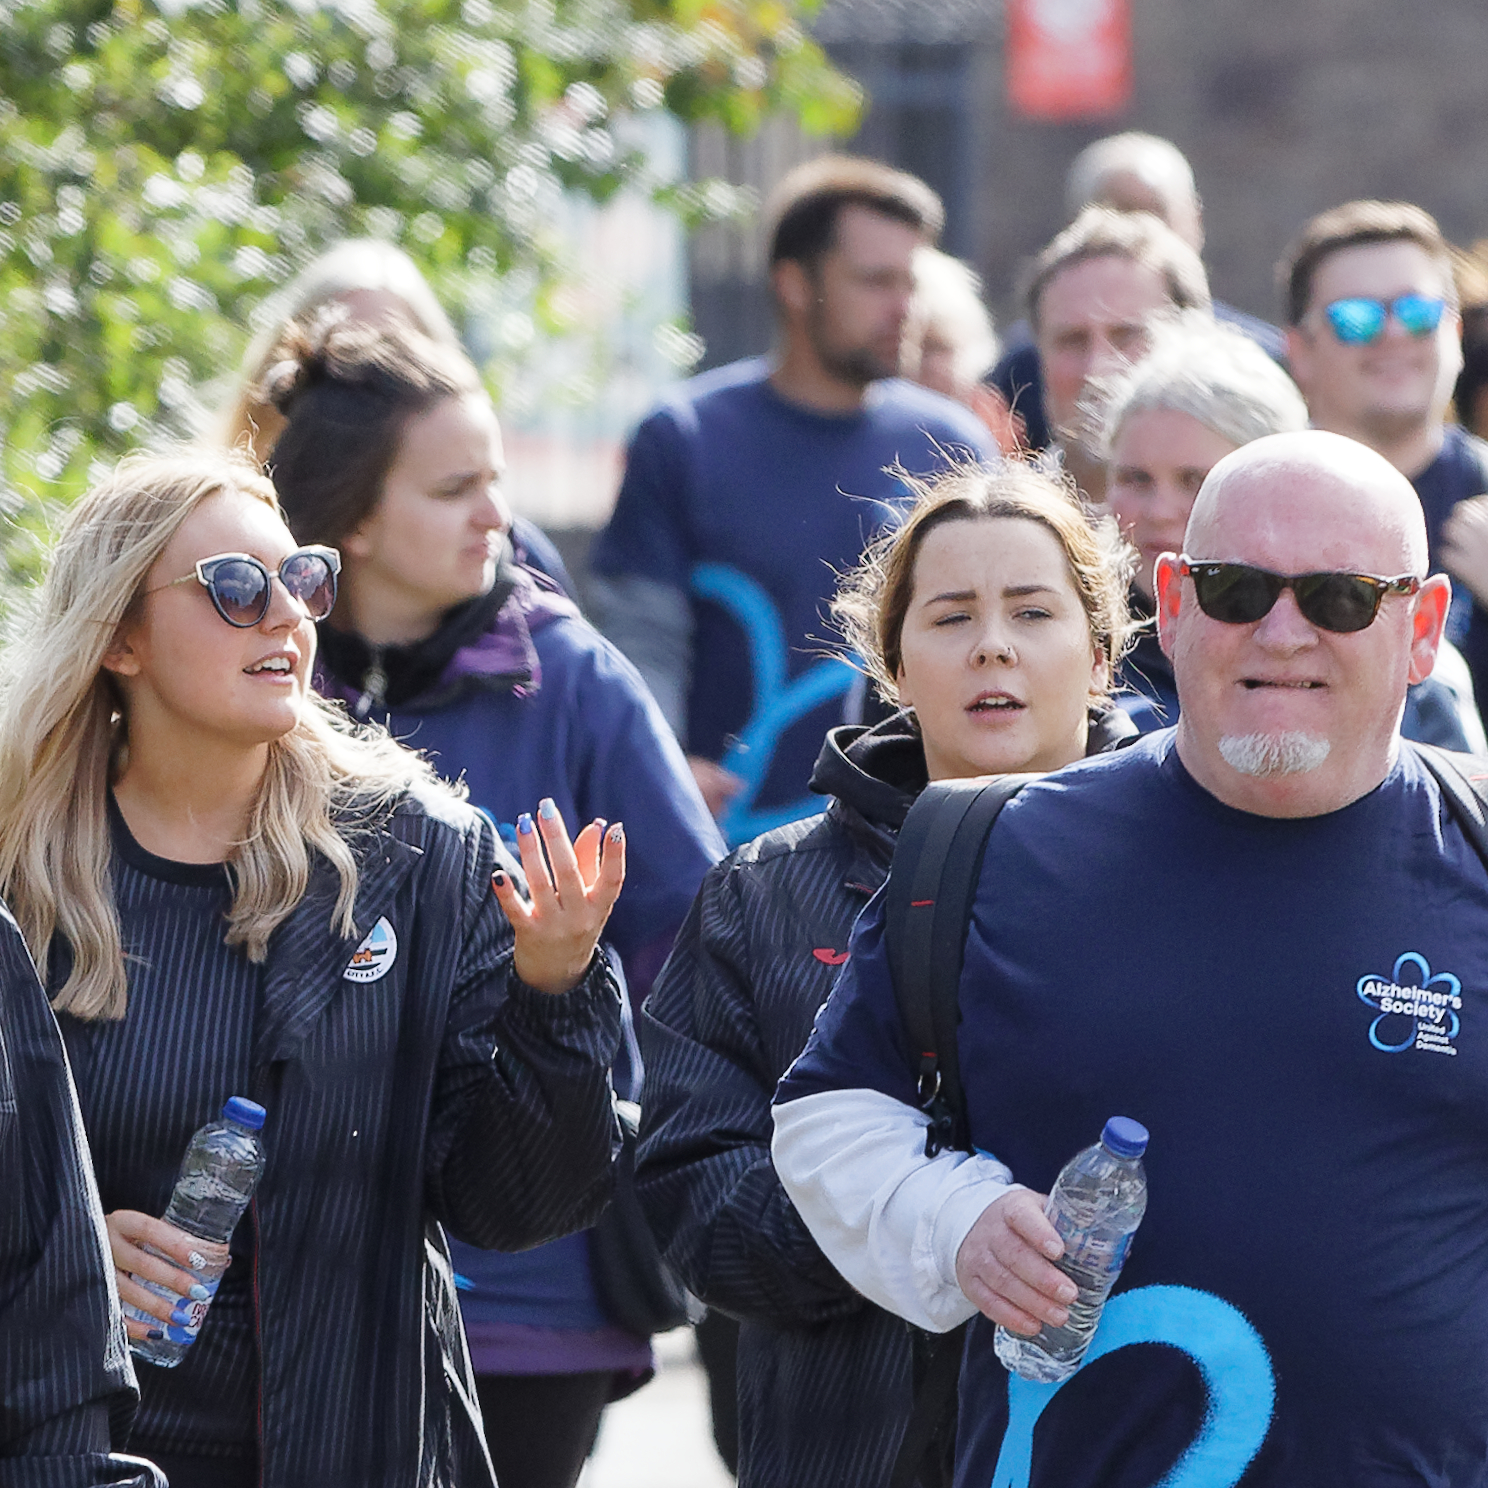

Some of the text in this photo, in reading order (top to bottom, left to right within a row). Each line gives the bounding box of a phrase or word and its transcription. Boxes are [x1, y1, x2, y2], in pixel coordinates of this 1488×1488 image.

[1363, 981, 1462, 1009] Alzheimer's
[1380, 997, 1446, 1023] Society
[1417, 1022, 1446, 1034] United
[1416, 1040, 1457, 1055] Dementia
